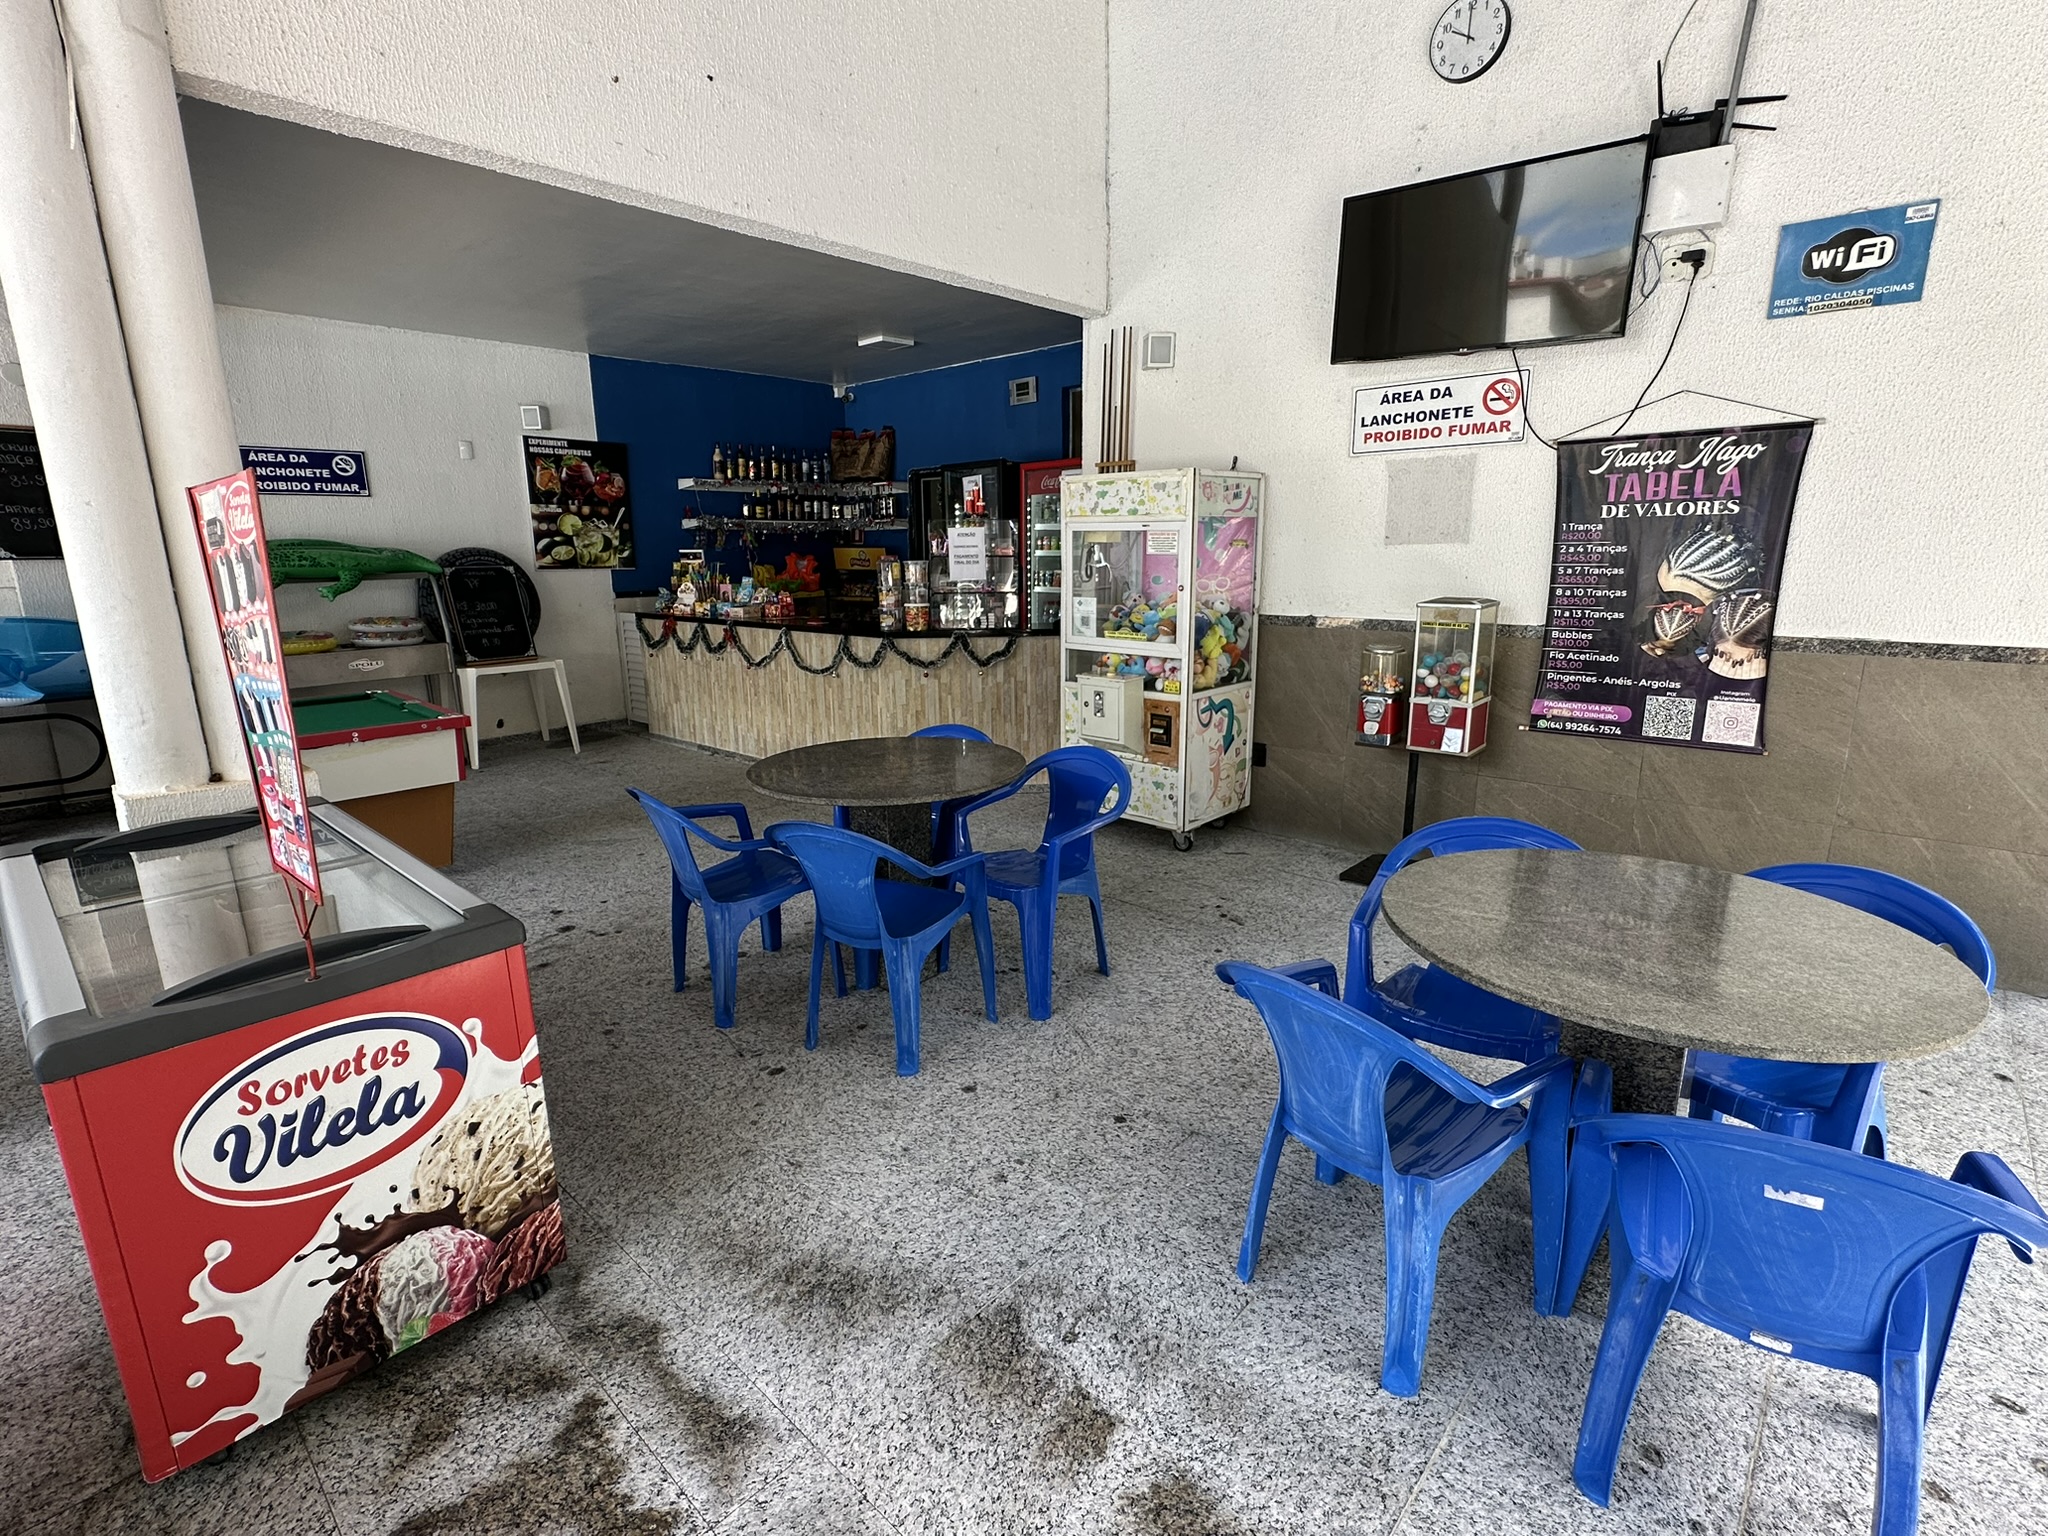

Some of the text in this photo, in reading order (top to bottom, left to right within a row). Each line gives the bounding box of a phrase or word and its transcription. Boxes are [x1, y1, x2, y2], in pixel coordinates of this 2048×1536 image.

[1455, 8, 1461, 19] 11
[1493, 7, 1500, 19] 2
[1442, 22, 1452, 35] 10
[1496, 23, 1503, 34] 3
[1436, 40, 1444, 52] 9
[1489, 42, 1495, 52] 4
[1440, 56, 1446, 66] 8
[1477, 56, 1484, 66] 5
[1449, 64, 1456, 74] 7
[1462, 64, 1469, 74] 6
[1774, 282, 1915, 307] REDE: RIO CALDAS PISCINAS
[1772, 297, 1873, 316] SENHA: 1020304050
[1380, 386, 1453, 406] ÁREA DA
[1360, 405, 1475, 428] LANCHONETE
[1363, 420, 1512, 444] PROIBIDO FUMAR
[528, 438, 568, 447] EXPERIMENTE
[248, 451, 308, 463] ÁREA DA
[1588, 436, 1767, 476] Trança Nago
[255, 467, 331, 478] NCHONETE
[256, 482, 310, 490] ROIBIDO
[314, 482, 360, 492] FUMAR
[1604, 467, 1742, 503] TABELA
[1600, 500, 1740, 519] DE VALORES
[1562, 523, 1603, 532] 1 Trança
[1562, 532, 1601, 540] R$20,00
[1560, 545, 1566, 553] 2
[1586, 544, 1628, 554] Tranças
[1560, 554, 1601, 562] R$45,00
[1574, 567, 1582, 575] 7
[1584, 566, 1624, 576] Tranças
[1558, 576, 1598, 584] R$65,00
[1586, 589, 1628, 598] Tranças
[1556, 597, 1596, 605] R$95,00
[1584, 610, 1624, 620] Tranças
[1553, 618, 1594, 627] R$115,00
[1552, 631, 1593, 640] Bubbles
[1551, 640, 1590, 648] R$10,00
[1550, 652, 1620, 662] Fio Acetinado
[1548, 660, 1582, 668] R$5,00
[1546, 682, 1580, 690] R$5,00
[1547, 672, 1597, 684] Pingentes
[1602, 676, 1632, 686] Anéis
[1638, 679, 1681, 690] Argolas
[1544, 701, 1587, 710] PAGAMENTO
[1584, 712, 1618, 720] DINHEIRO
[1548, 720, 1621, 734] (64) 99264-7574
[237, 1039, 410, 1116] Sorvetes
[213, 1074, 426, 1184] Vilela
